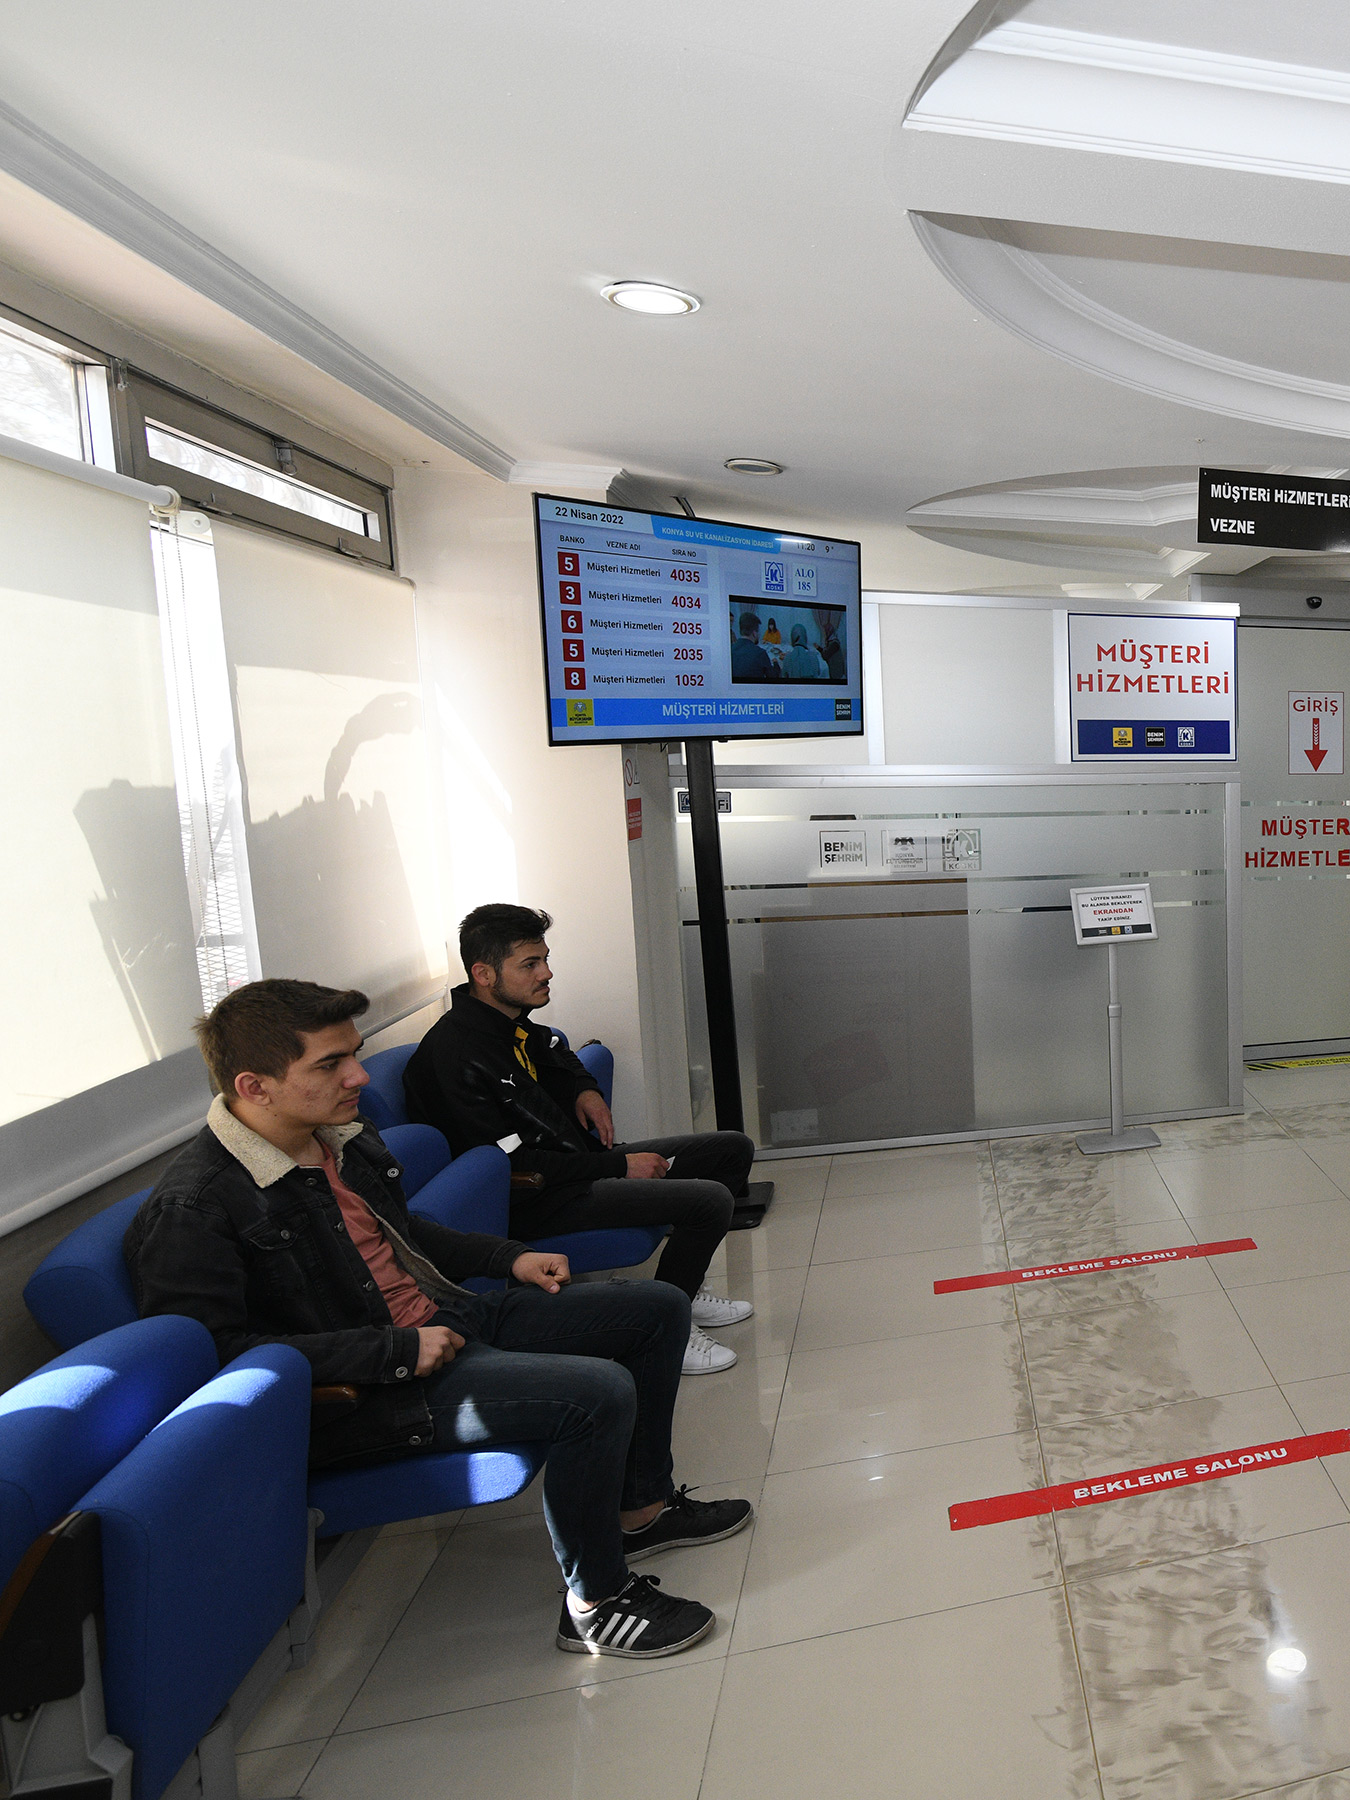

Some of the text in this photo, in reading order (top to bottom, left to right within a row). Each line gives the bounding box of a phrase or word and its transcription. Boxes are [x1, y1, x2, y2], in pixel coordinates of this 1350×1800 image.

[555, 506, 624, 525] 22 Nisan 2022
[1210, 518, 1255, 534] VEZNE
[662, 527, 684, 537] KONYA
[685, 530, 694, 538] SU
[695, 532, 703, 540] VE
[704, 533, 751, 545] KANALİZASYON
[559, 534, 697, 558] BANKO VEZNE ADI SIRA NO
[564, 557, 700, 583] 5 Müşteri Hizmetleri 4035
[794, 568, 814, 579] ALO
[797, 581, 811, 591] 185
[565, 586, 701, 609] 3 Müşteri Hizmetleri 4034
[567, 615, 702, 635] 6 Müşteri Hizmetleri 2035
[569, 643, 703, 661] 5 Müşteri Hizmetleri 2035
[1097, 639, 1209, 669] MÜŞTERİ
[570, 672, 704, 687] 8 Müşteri Hizmetleri 1052
[1077, 669, 1229, 694] HİZMETLERİ
[662, 702, 785, 719] MÜŞTERİ HİZMETLERİ
[1293, 696, 1339, 716] GİRİŞ
[1093, 907, 1134, 915] EKRANDAN
[1021, 1250, 1178, 1279] BEKLEME SALONU
[1073, 1447, 1288, 1499] BEKLEME SALONU
